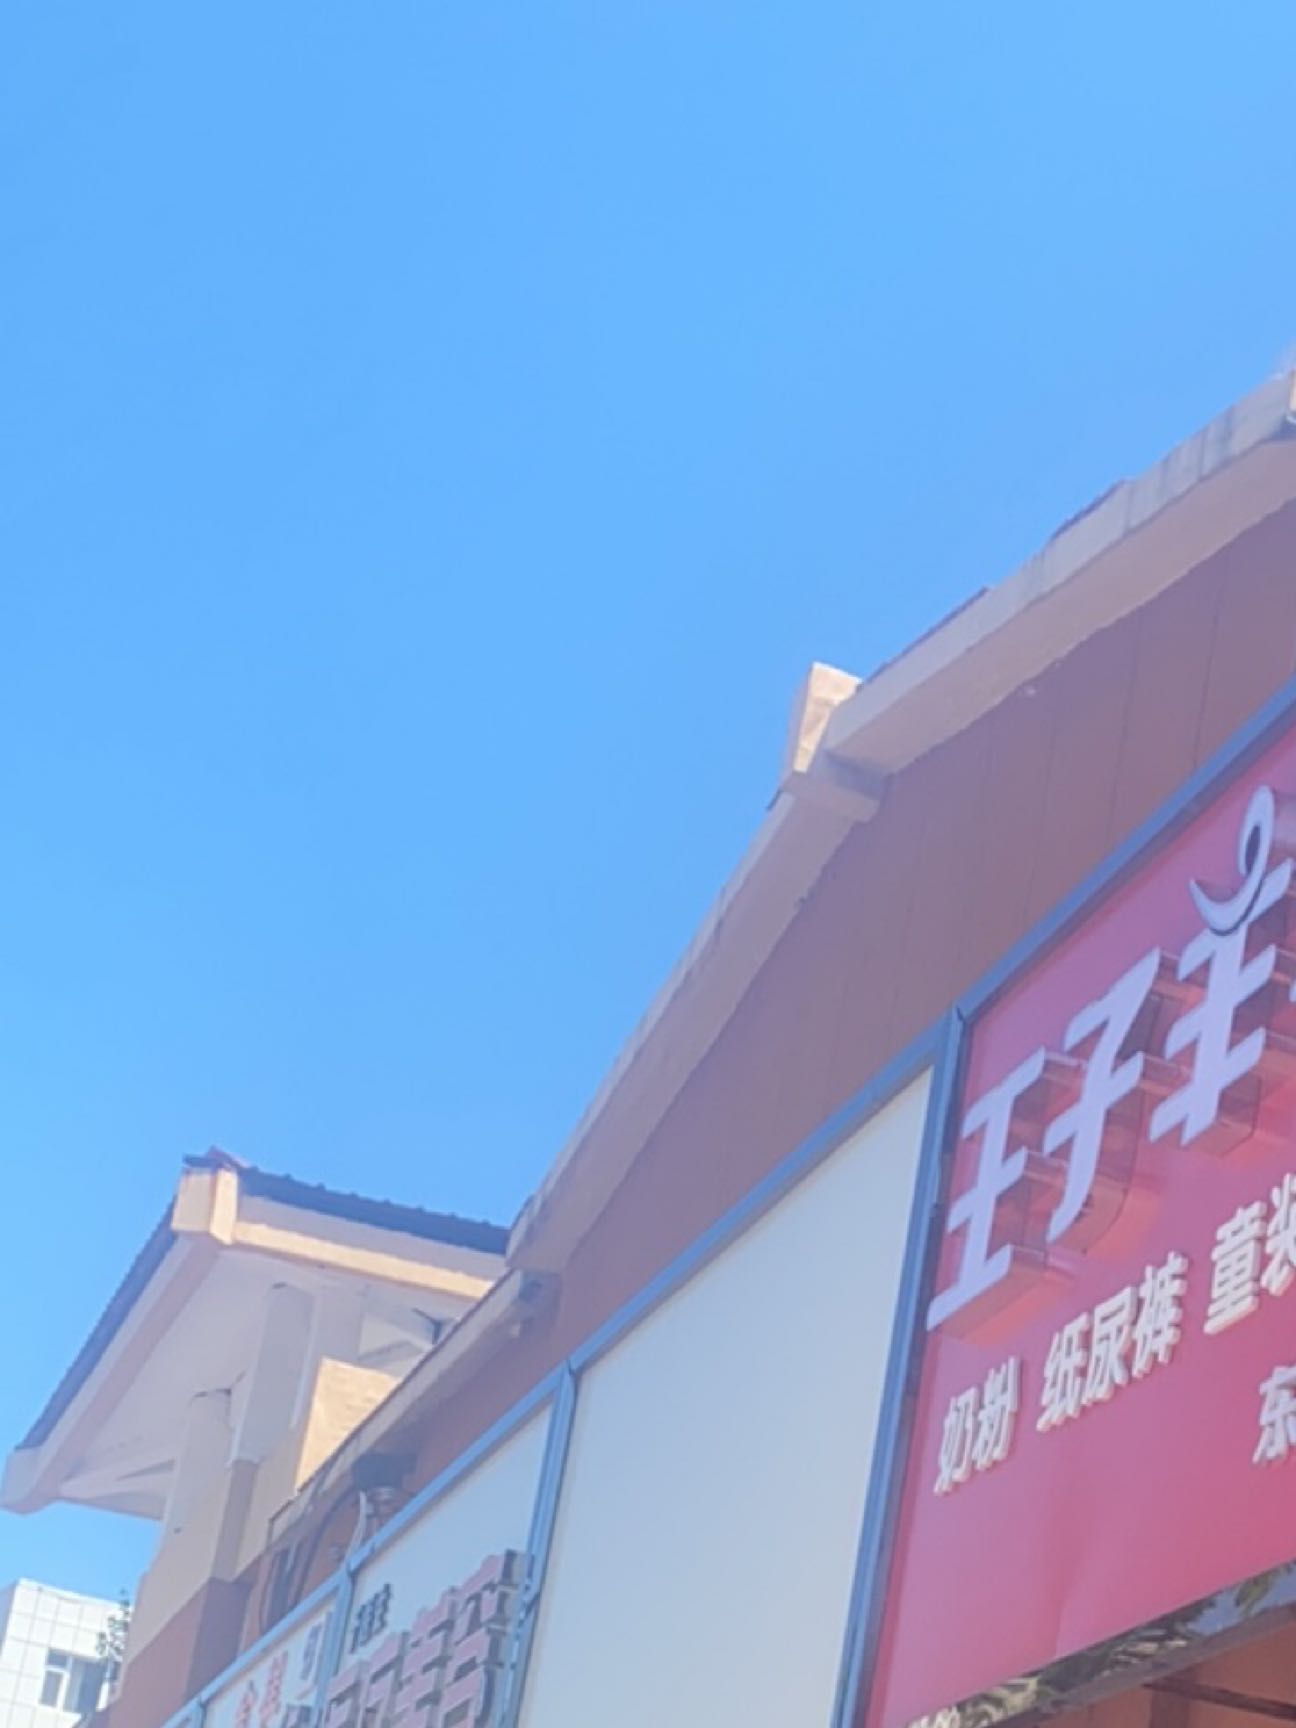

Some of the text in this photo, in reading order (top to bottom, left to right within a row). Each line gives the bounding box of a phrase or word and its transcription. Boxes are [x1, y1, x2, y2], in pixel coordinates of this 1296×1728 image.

[933, 1358, 1018, 1494] 奶粉
[1036, 1250, 1189, 1429] 纸尿裤
